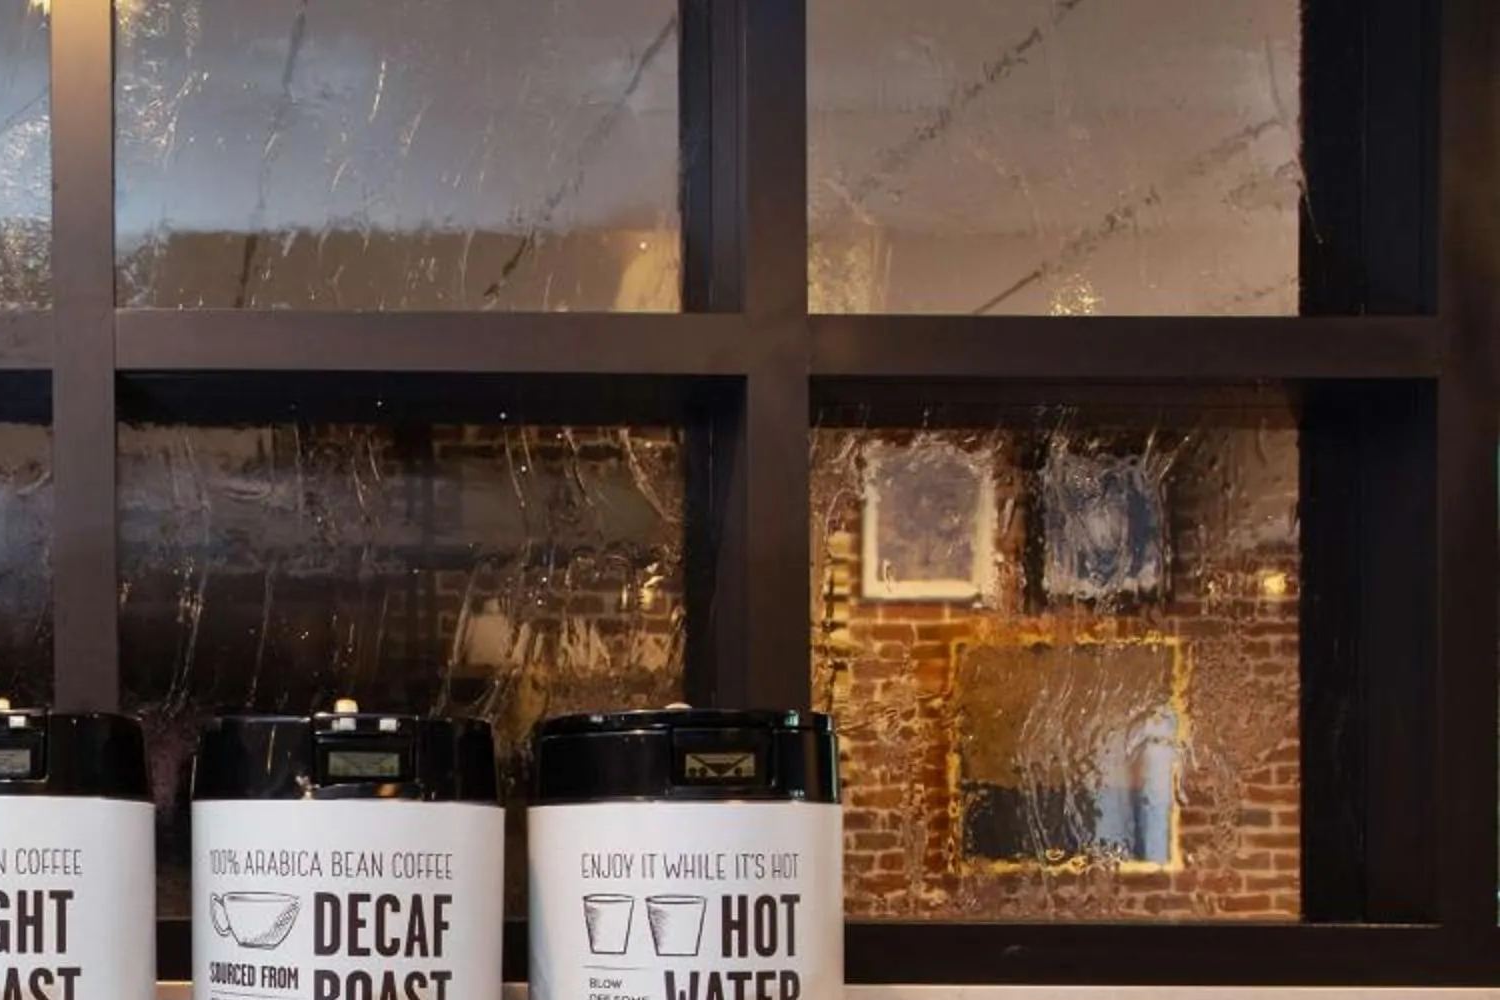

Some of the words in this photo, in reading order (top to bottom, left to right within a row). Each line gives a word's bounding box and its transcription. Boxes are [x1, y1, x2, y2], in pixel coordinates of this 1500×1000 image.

[15, 848, 83, 876] COFFEE
[244, 849, 323, 877] ARABICA
[331, 851, 384, 878] BEAN
[391, 852, 453, 880] COFFEE
[581, 853, 634, 879] ENJOY
[641, 853, 657, 879] IT
[663, 853, 726, 880] WHILE
[735, 853, 765, 880] IT'S
[771, 853, 799, 880] HOT
[313, 892, 453, 957] DECAF
[721, 894, 801, 958] HOT
[209, 962, 256, 987] SOURCED
[261, 965, 299, 991] FROM
[589, 977, 622, 989] BLOW
